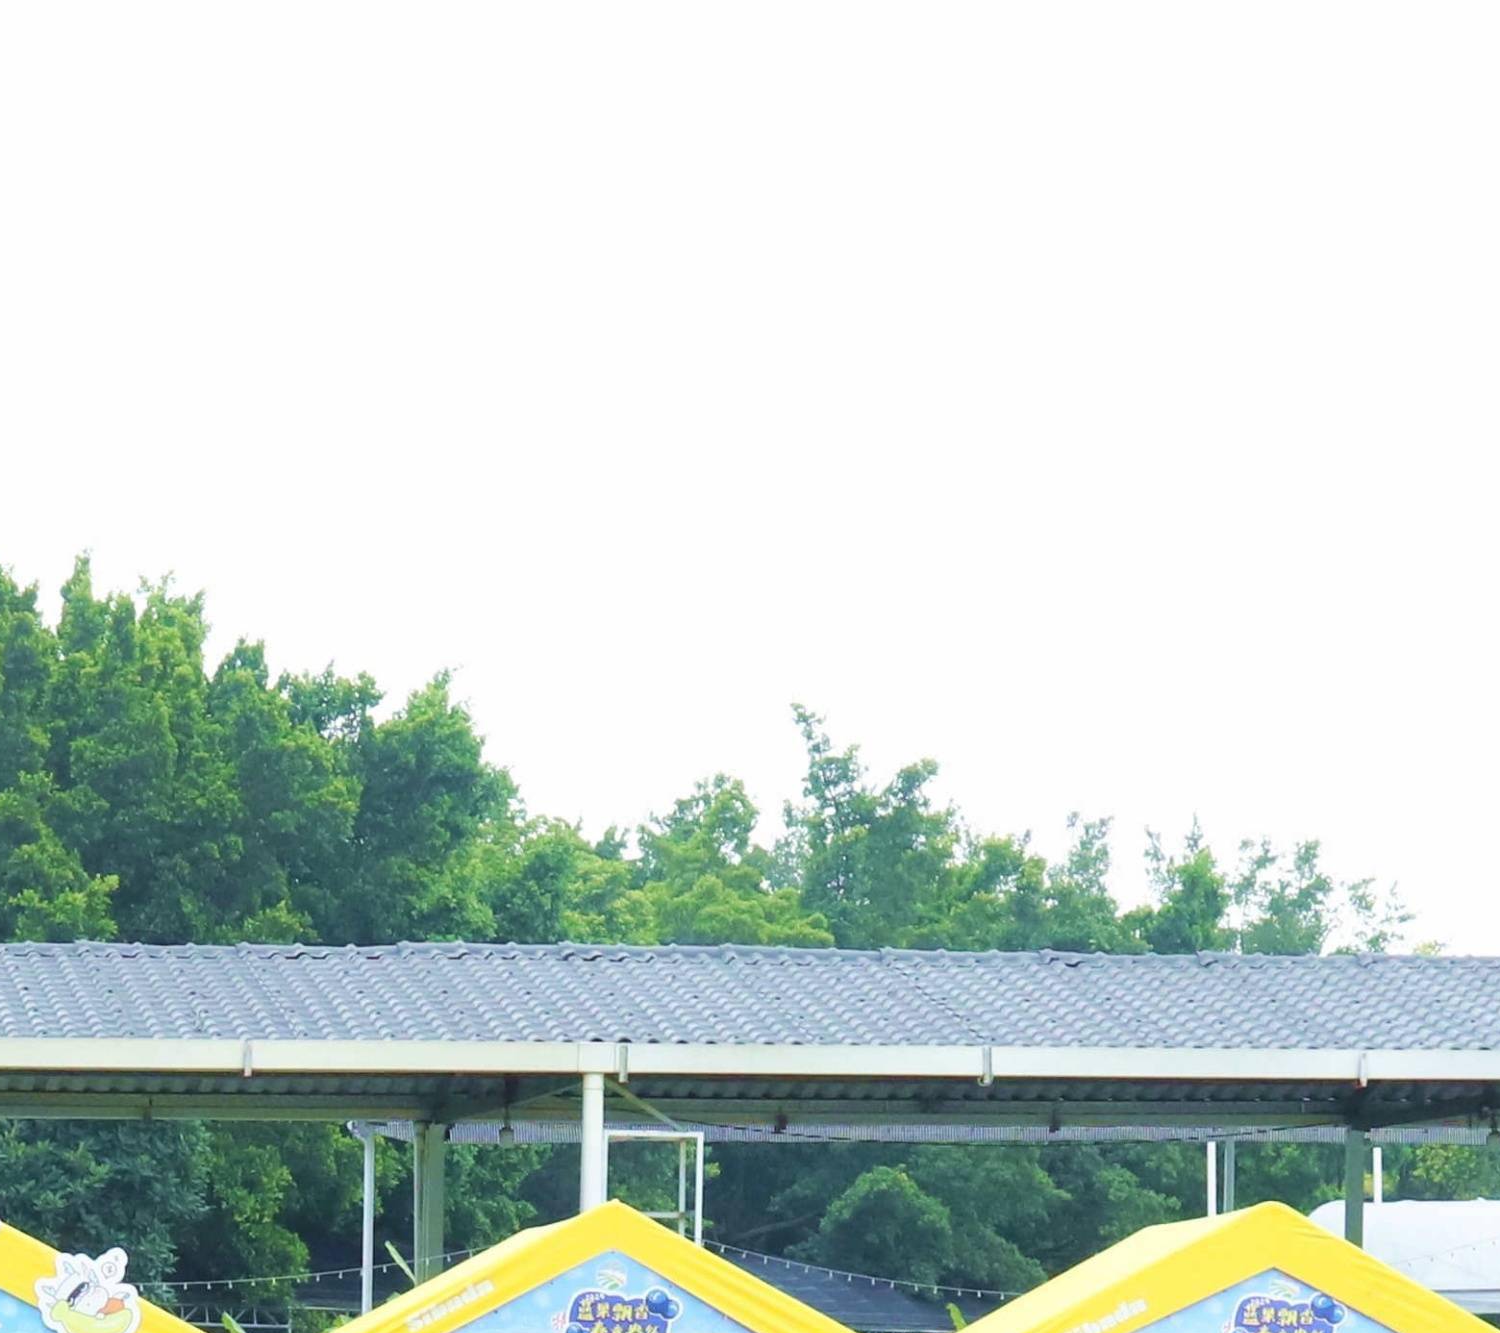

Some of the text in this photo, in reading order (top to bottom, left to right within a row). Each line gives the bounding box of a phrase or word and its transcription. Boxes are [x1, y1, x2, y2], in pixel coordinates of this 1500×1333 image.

[578, 1298, 648, 1321] 蓝果飘香
[1243, 1302, 1313, 1326] 蓝果飘香
